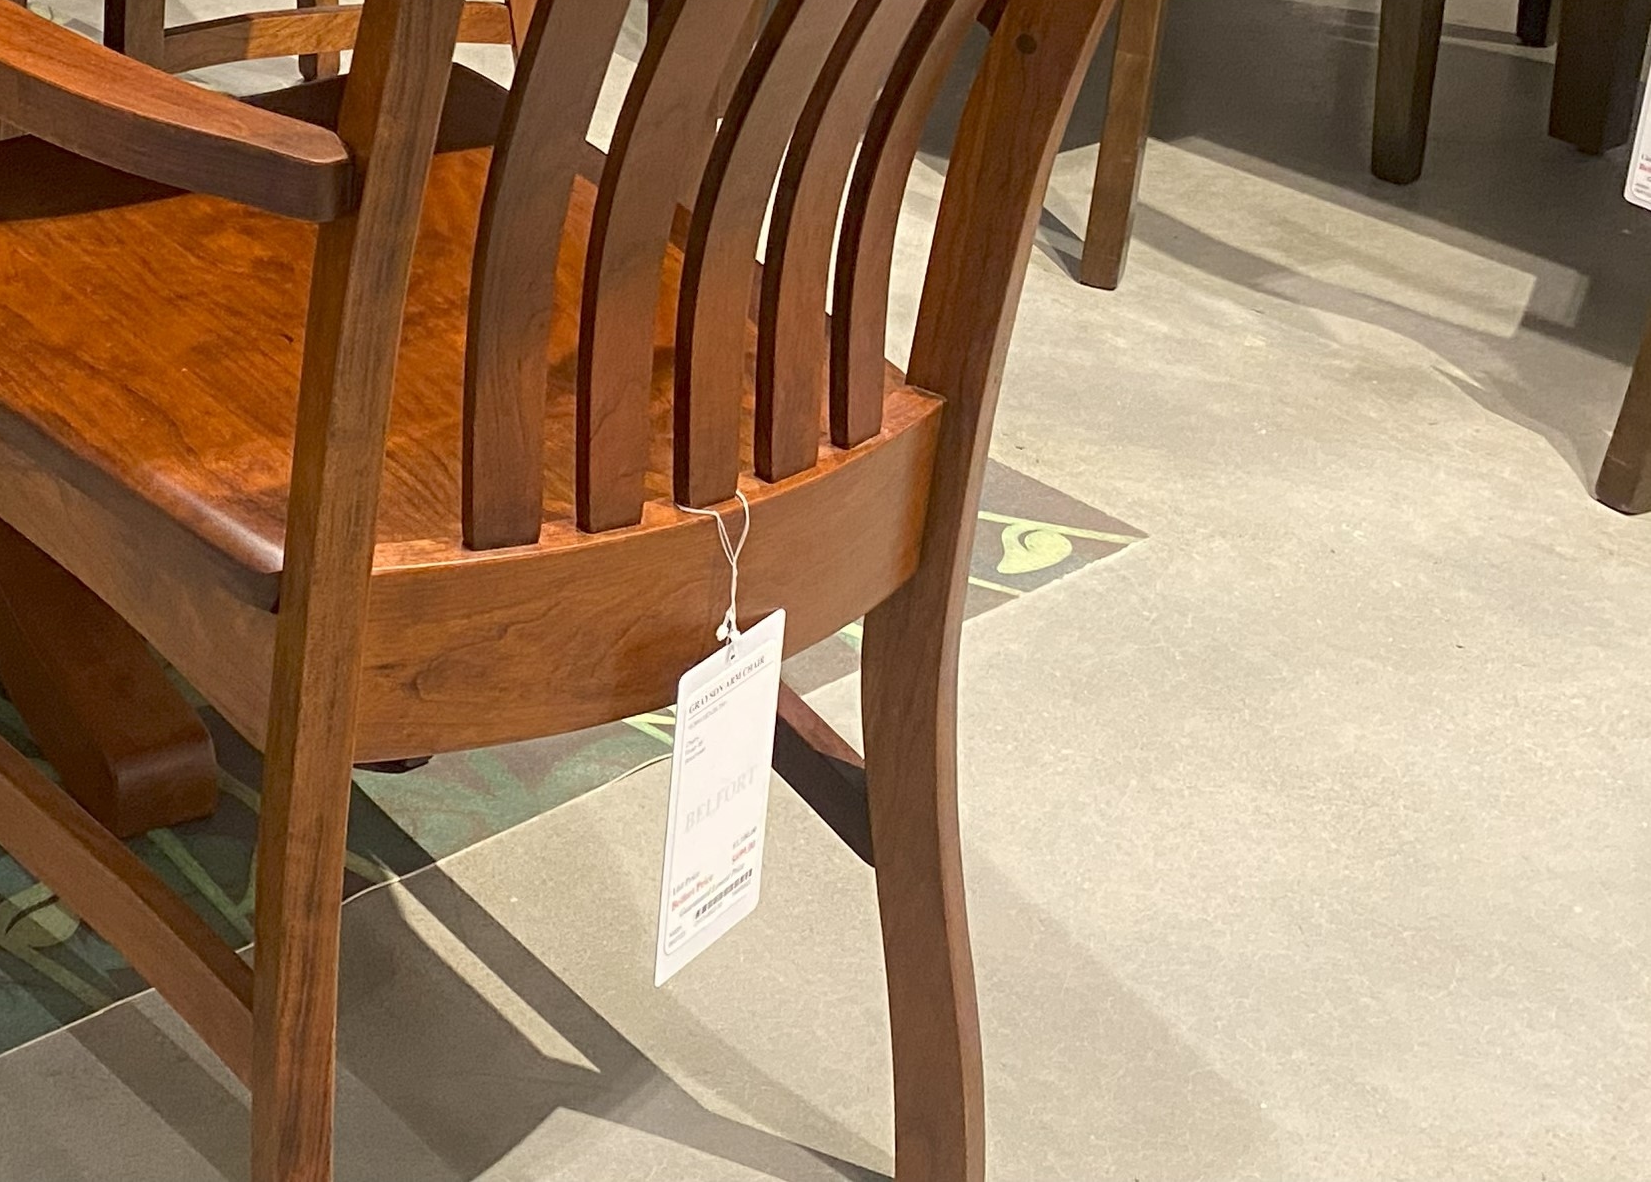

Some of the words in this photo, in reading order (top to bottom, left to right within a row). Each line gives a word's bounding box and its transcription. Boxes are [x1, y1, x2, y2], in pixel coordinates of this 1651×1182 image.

[726, 671, 742, 688] ARM
[742, 655, 765, 678] CHAIR
[684, 764, 758, 834] BELFORT
